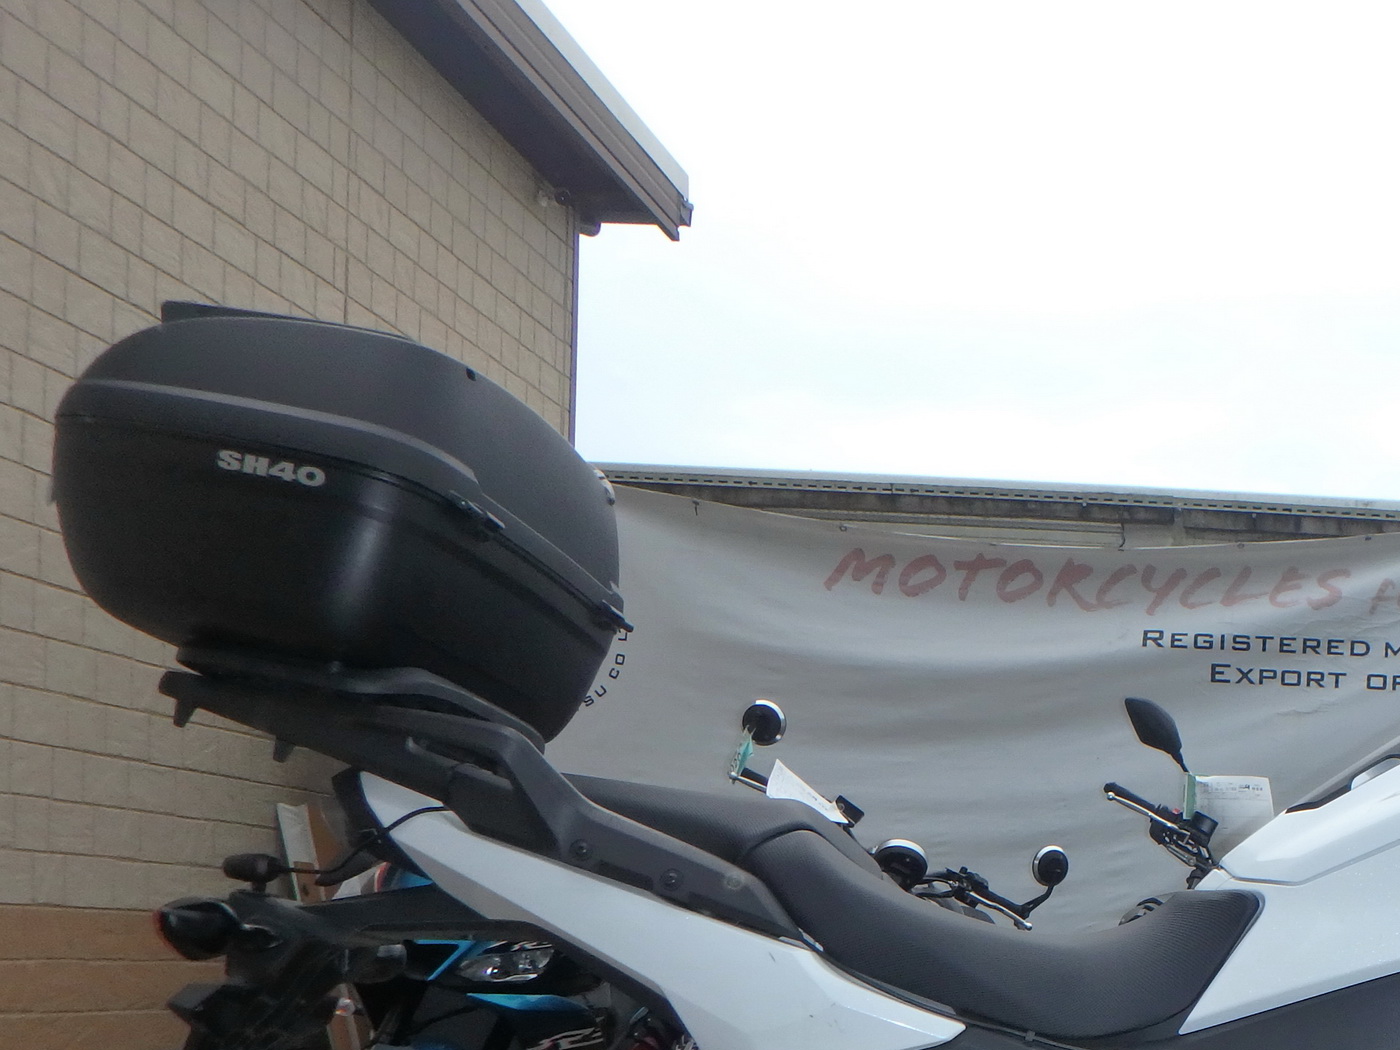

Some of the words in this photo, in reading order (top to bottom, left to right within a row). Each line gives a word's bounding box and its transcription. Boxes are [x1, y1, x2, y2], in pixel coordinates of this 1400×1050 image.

[217, 449, 326, 487] SH40
[823, 547, 1352, 616] MOTORCYCLES
[1141, 629, 1371, 658] REGISTERED
[1210, 662, 1347, 689] EXPORT
[583, 685, 607, 707] SU
